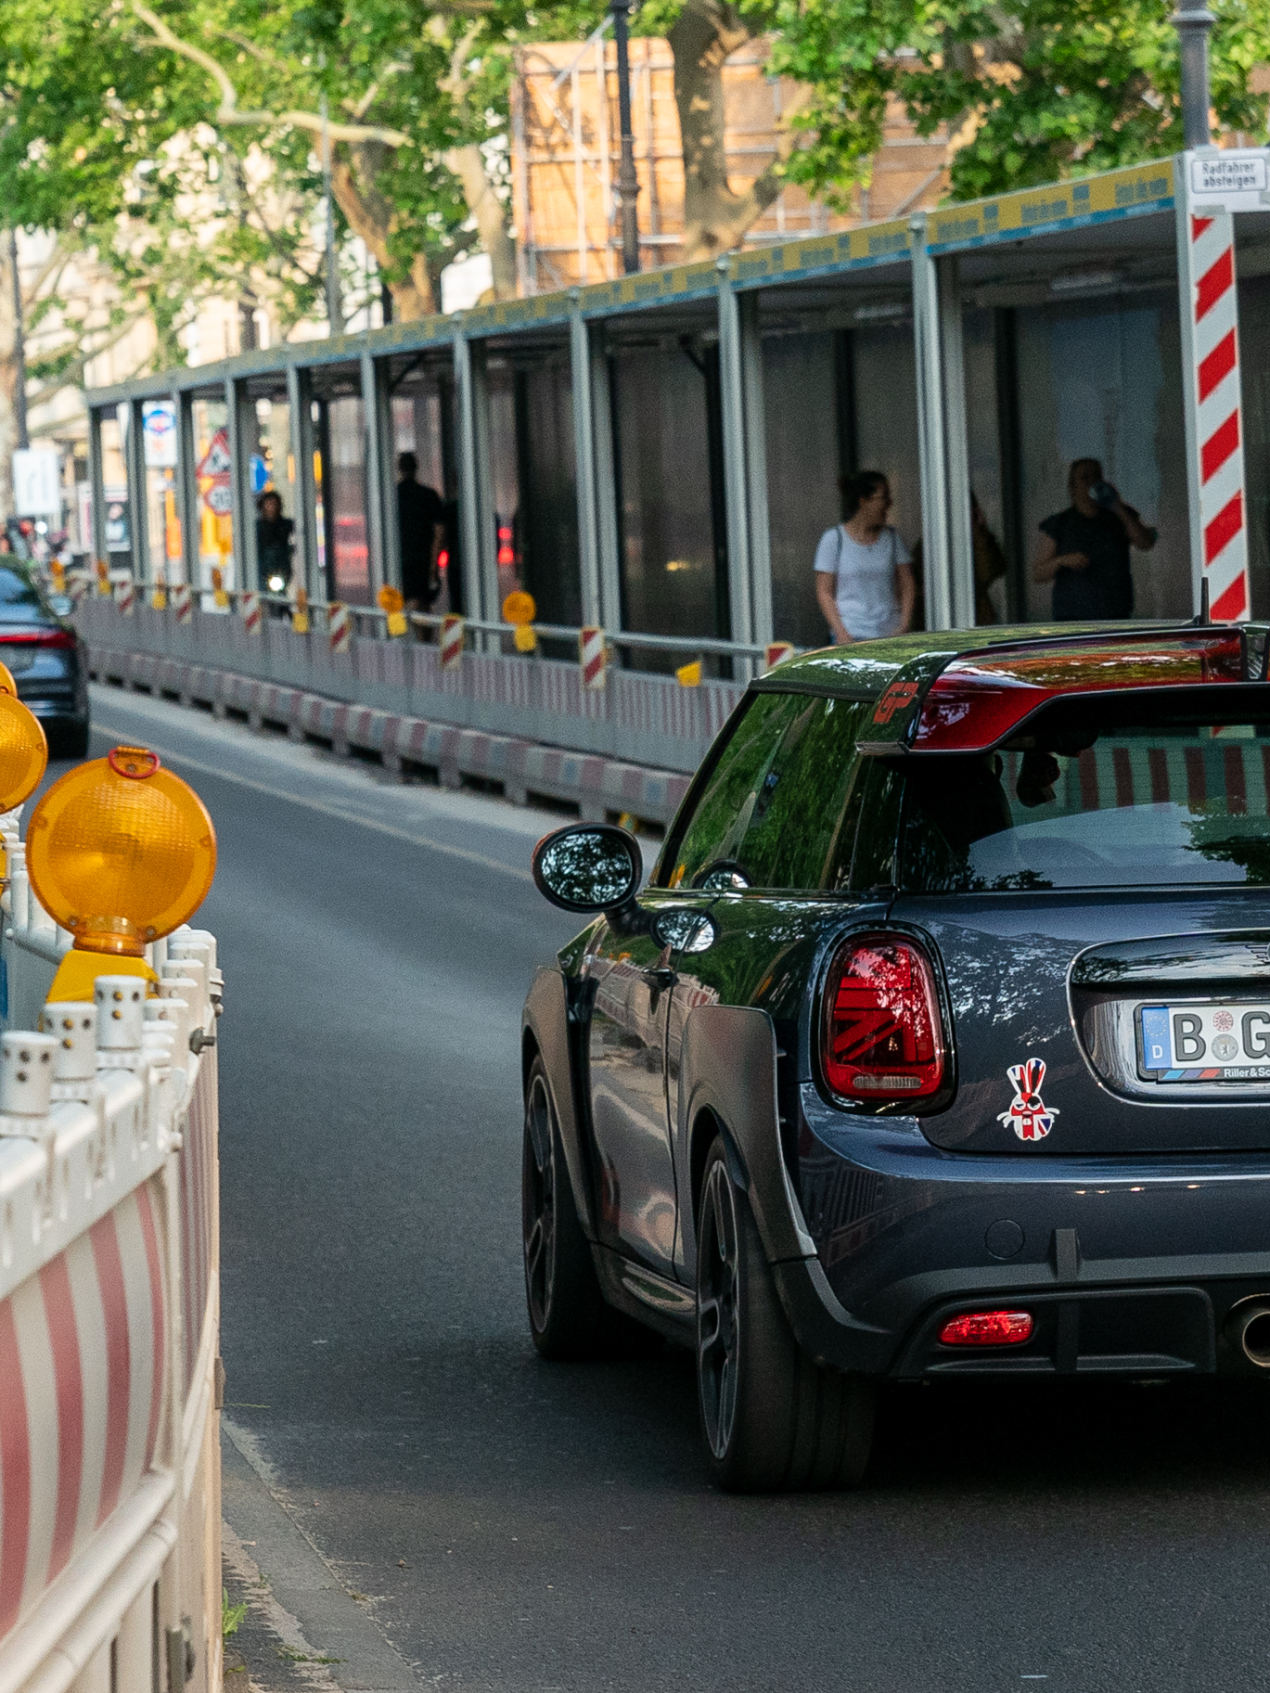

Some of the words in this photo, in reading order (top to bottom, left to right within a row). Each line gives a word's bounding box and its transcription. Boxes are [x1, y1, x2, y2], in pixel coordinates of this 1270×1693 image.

[1202, 162, 1254, 174] Radfahrer
[1203, 175, 1256, 189] absteigen
[873, 682, 919, 724] GP
[1173, 1013, 1206, 1062] B
[1152, 1045, 1163, 1059] D
